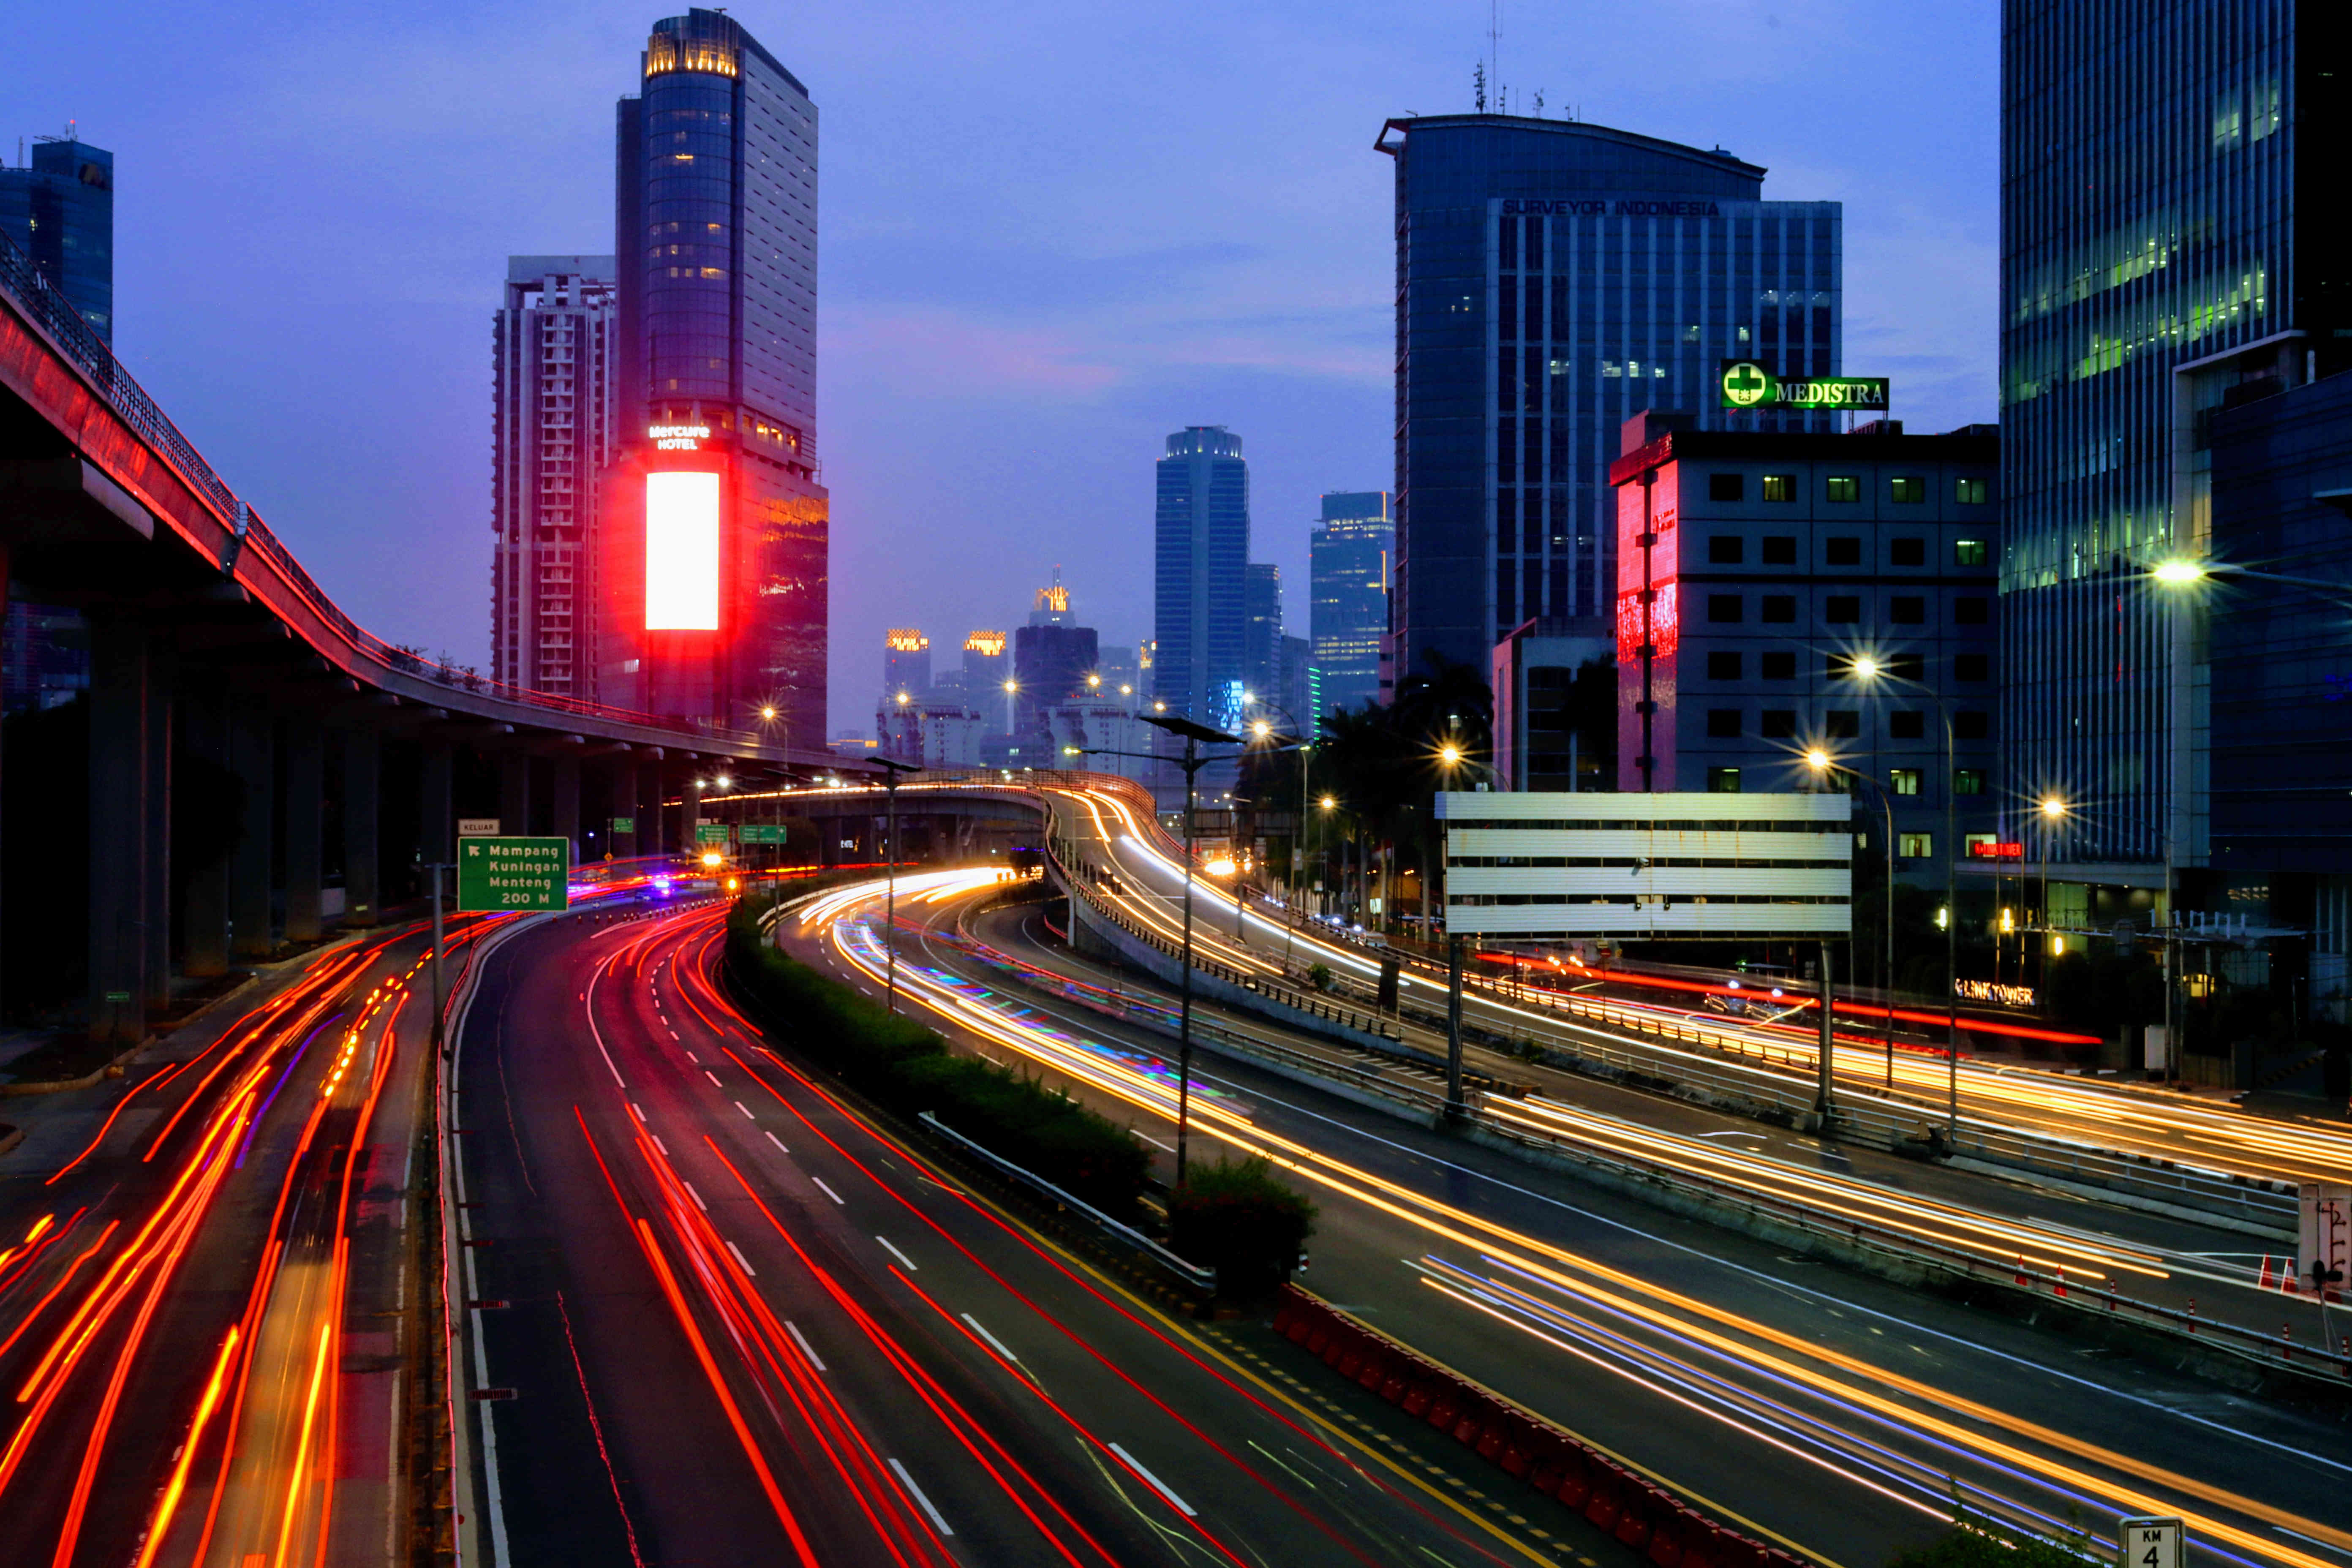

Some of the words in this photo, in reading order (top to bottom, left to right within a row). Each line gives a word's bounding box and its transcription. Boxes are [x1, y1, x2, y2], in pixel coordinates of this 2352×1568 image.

[1503, 199, 1606, 215] SURVEYOR
[1615, 201, 1719, 216] INDONESIA
[1775, 383, 1884, 403] MEDISTRA
[658, 438, 698, 450] HOTEL
[490, 845, 558, 858] Mampang
[490, 861, 560, 874] Kuningan
[490, 877, 551, 890] Menteng
[502, 893, 530, 904] 200
[539, 893, 549, 904] M
[1992, 984, 2035, 1006] TOWER
[2143, 1530, 2161, 1542] KM
[2143, 1546, 2159, 1568] 4
